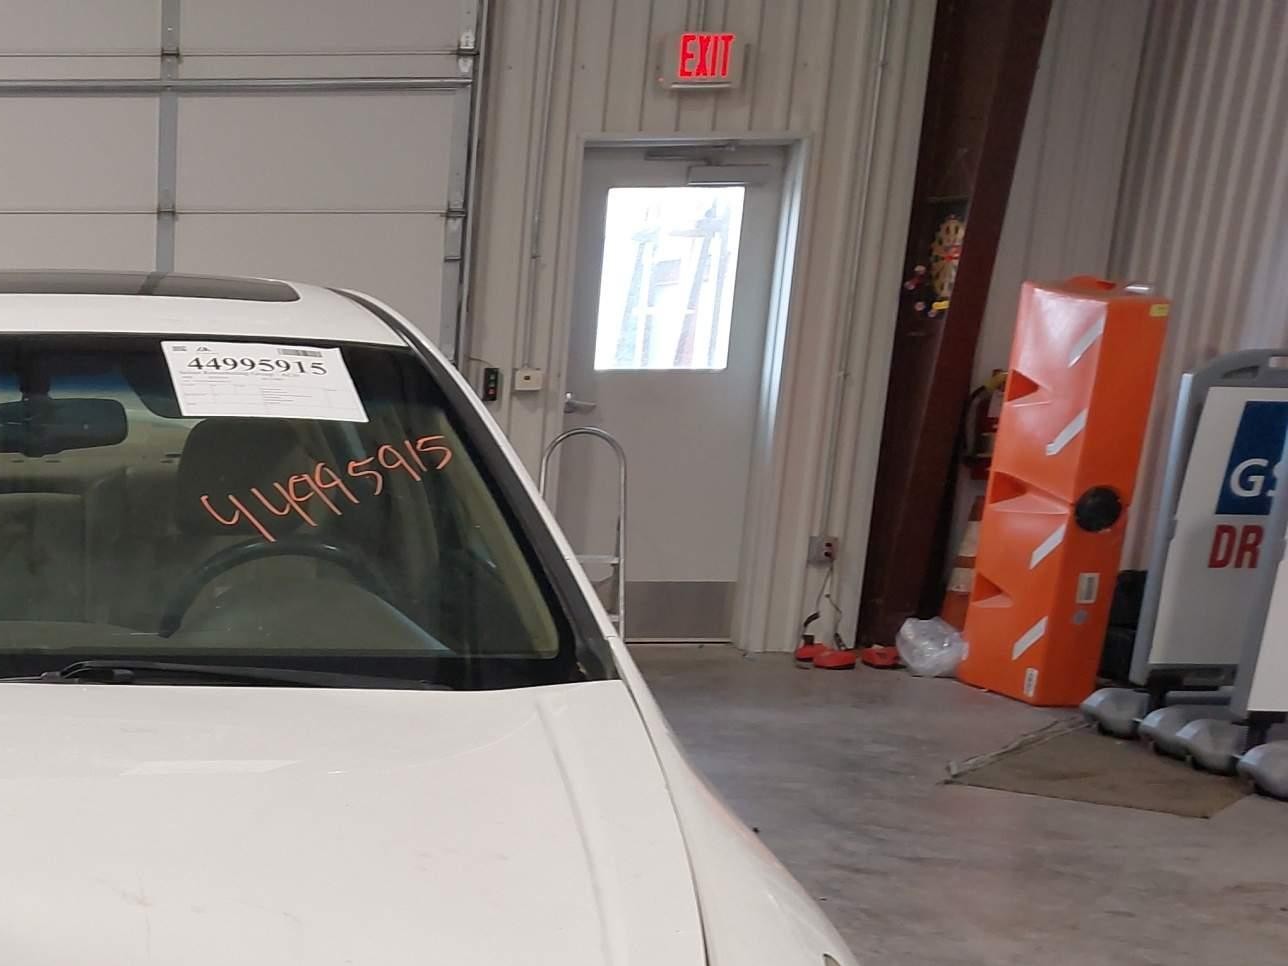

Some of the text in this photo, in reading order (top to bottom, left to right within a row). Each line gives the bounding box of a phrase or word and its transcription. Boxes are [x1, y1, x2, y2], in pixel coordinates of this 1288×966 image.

[679, 34, 734, 77] EXIT
[187, 357, 328, 376] 44995915
[200, 434, 454, 544] 44995915
[1208, 524, 1265, 569] DR
